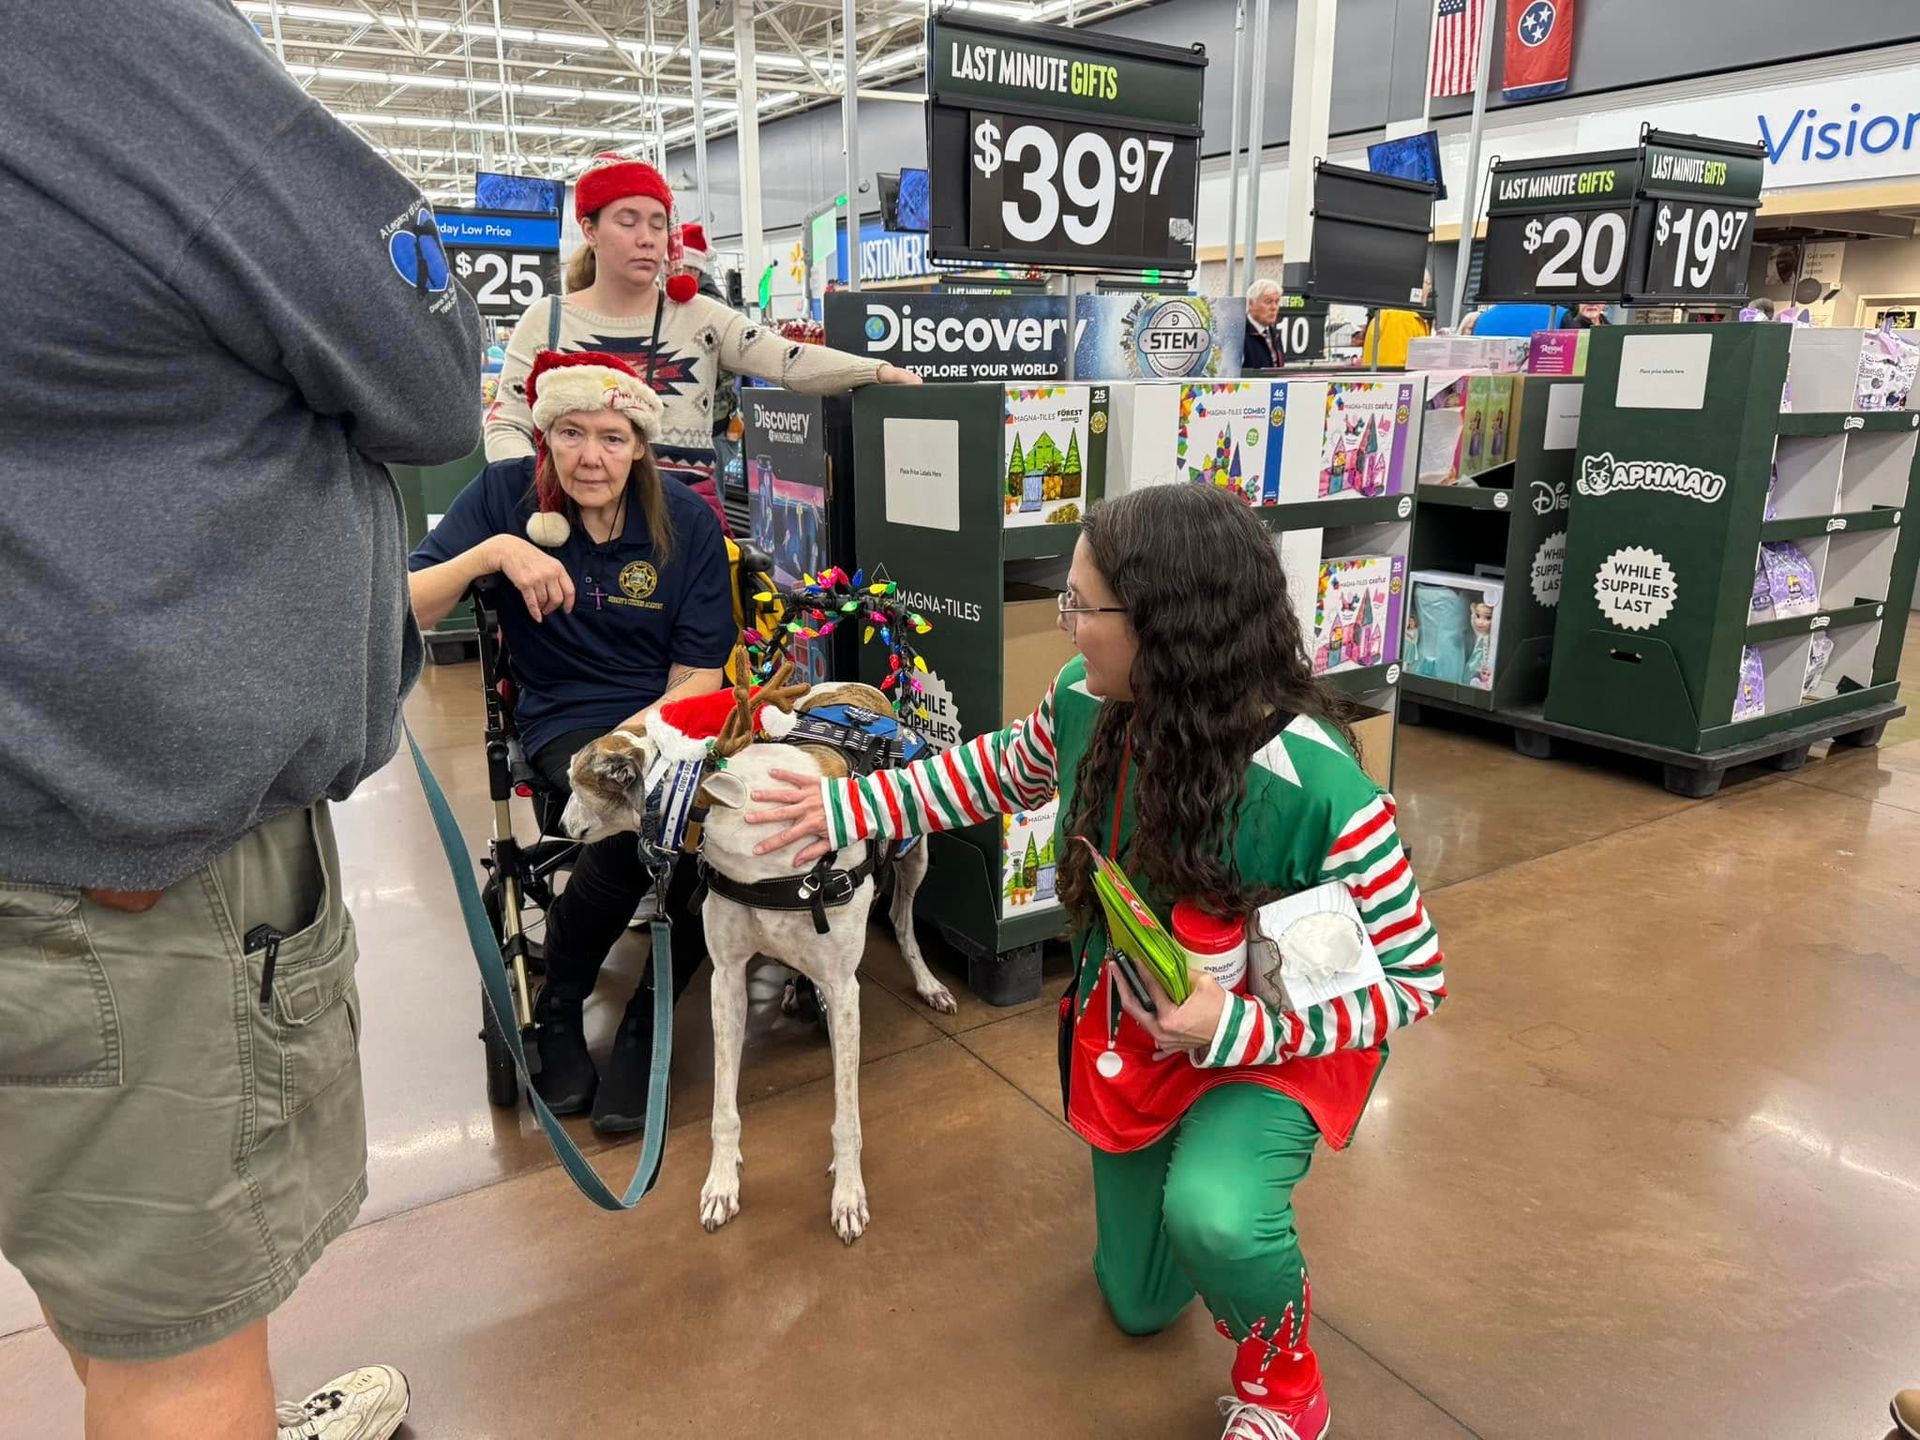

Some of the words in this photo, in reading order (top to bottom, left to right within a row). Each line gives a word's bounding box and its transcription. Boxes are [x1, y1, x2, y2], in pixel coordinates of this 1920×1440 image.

[951, 42, 996, 82] LAST
[998, 50, 1068, 93] MINUTE
[1070, 61, 1118, 100] GIFTS
[1499, 178, 1527, 200] LAST
[1528, 174, 1578, 198] MINUTE
[1577, 169, 1615, 194] GIFTS
[1651, 154, 1672, 179] LAST
[1672, 158, 1705, 184] MINUTE
[1704, 161, 1727, 186] GIFTS
[461, 223, 482, 235] Low
[485, 224, 512, 237] Price
[860, 235, 923, 279] USTOMER
[1523, 212, 1627, 288] $20
[455, 251, 544, 306] $25
[866, 304, 1087, 353] Discovery
[1150, 332, 1198, 349] STEM
[906, 364, 967, 378] EXPLORE
[970, 364, 1008, 377] YOUR
[1012, 364, 1058, 377] WORLD
[1094, 390, 1105, 399] 25
[1273, 389, 1284, 397] 46
[754, 403, 809, 438] Discovery
[1530, 480, 1571, 515] Dis
[1612, 465, 1722, 499] APHMAU
[1544, 549, 1565, 561] WHIL
[1535, 564, 1562, 578] SUPPL
[1614, 563, 1662, 580] WHILE
[1601, 579, 1670, 599] SUPPLIES
[896, 588, 981, 622] MAGNA-TILES
[1614, 597, 1652, 614] LAST
